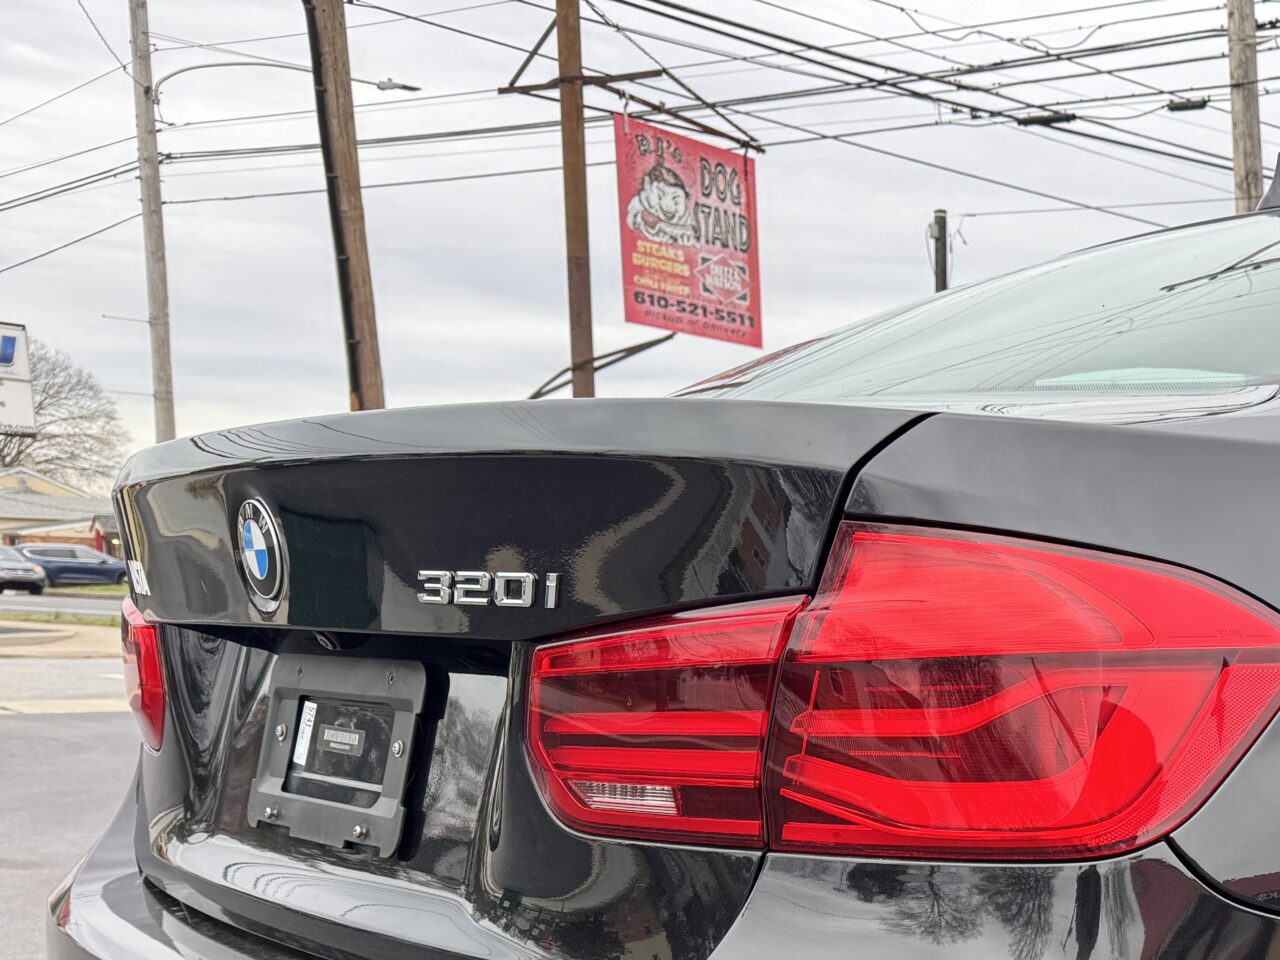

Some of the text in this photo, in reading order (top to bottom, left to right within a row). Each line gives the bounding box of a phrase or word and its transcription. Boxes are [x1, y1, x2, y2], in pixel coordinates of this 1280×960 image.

[700, 156, 742, 206] DOG
[692, 201, 751, 253] STAND
[633, 290, 755, 328] 610-521-5511
[238, 503, 269, 535] BMW
[417, 570, 562, 609] 320i
